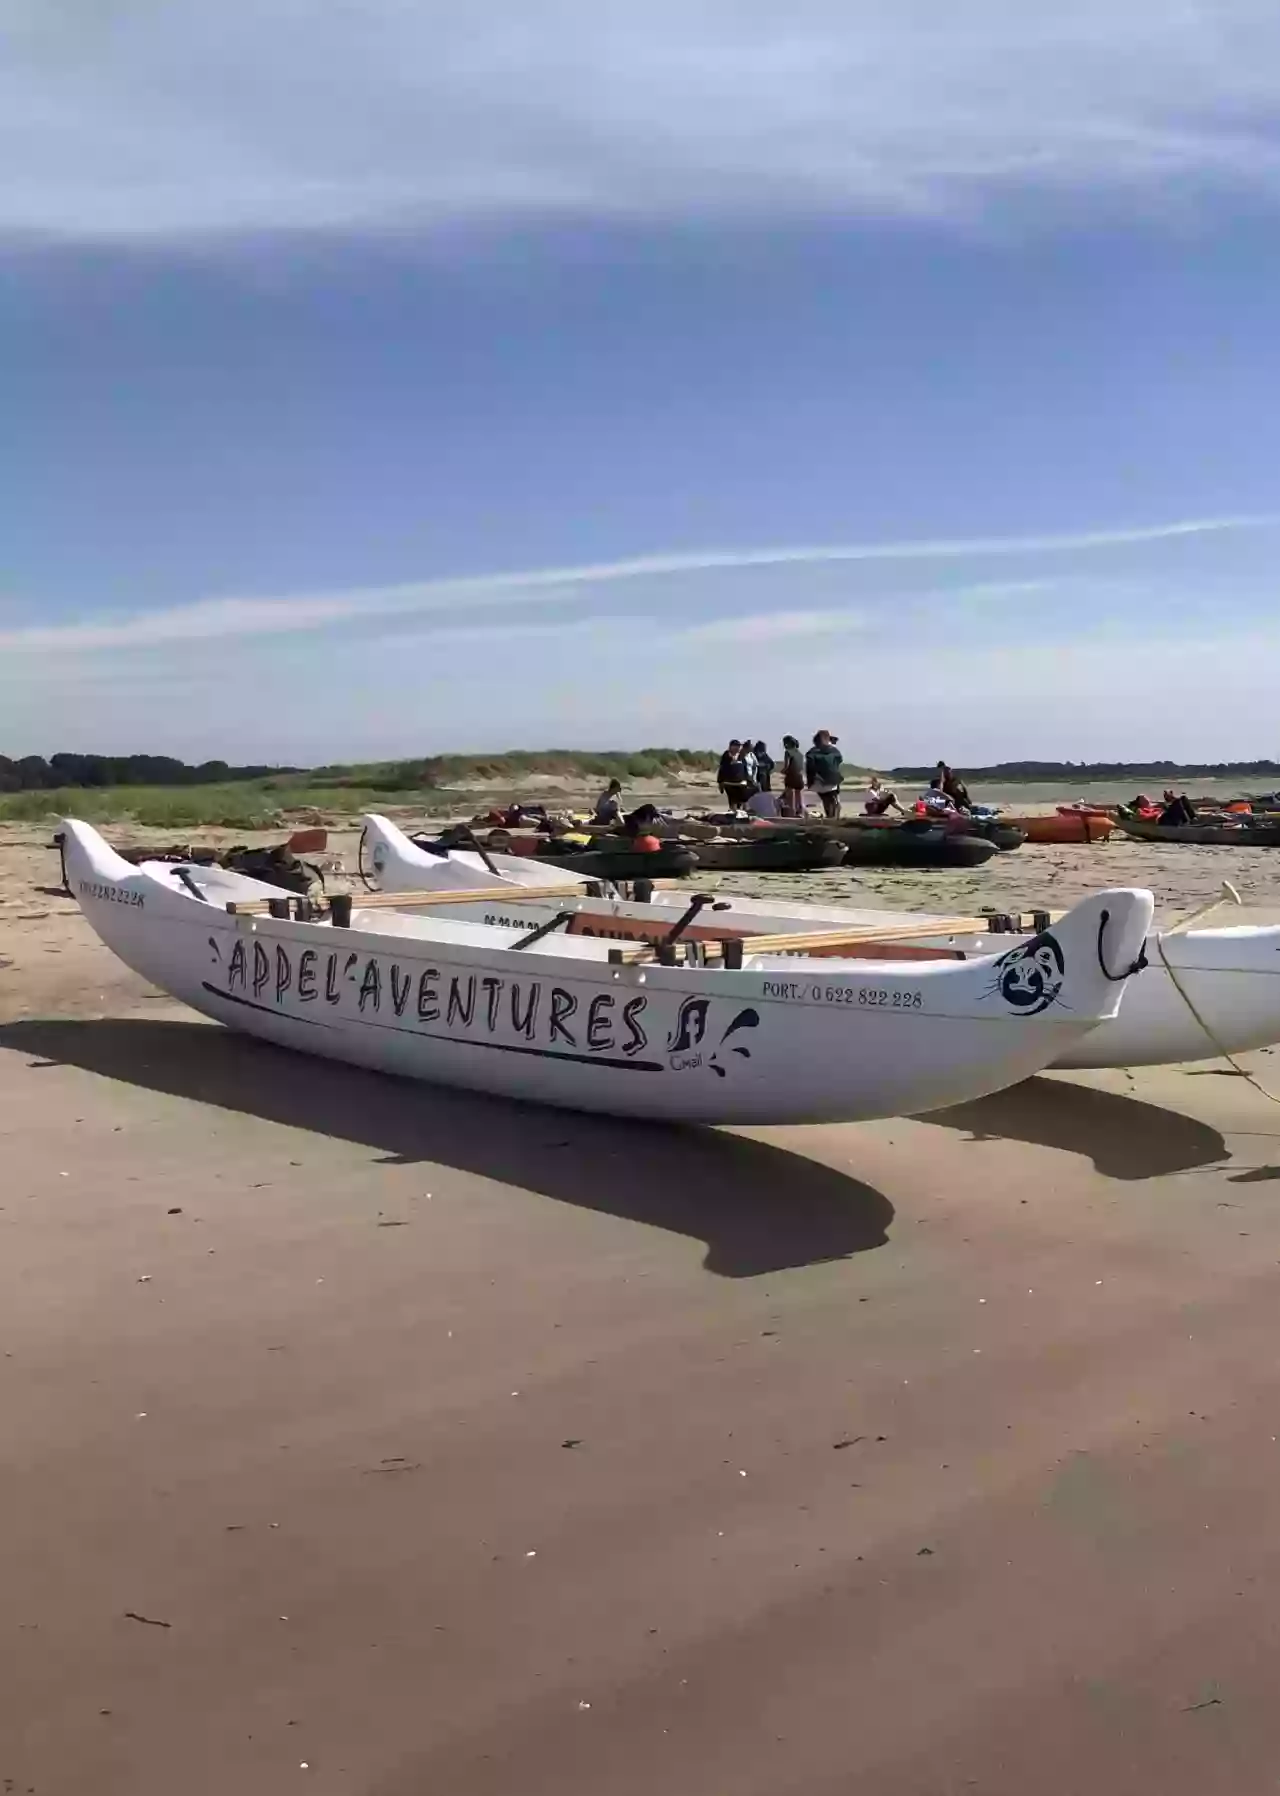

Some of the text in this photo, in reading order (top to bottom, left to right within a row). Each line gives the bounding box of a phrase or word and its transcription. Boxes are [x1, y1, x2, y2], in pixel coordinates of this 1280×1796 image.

[825, 987, 853, 1003] 622
[858, 988, 888, 1006] 822
[892, 991, 922, 1009] 228
